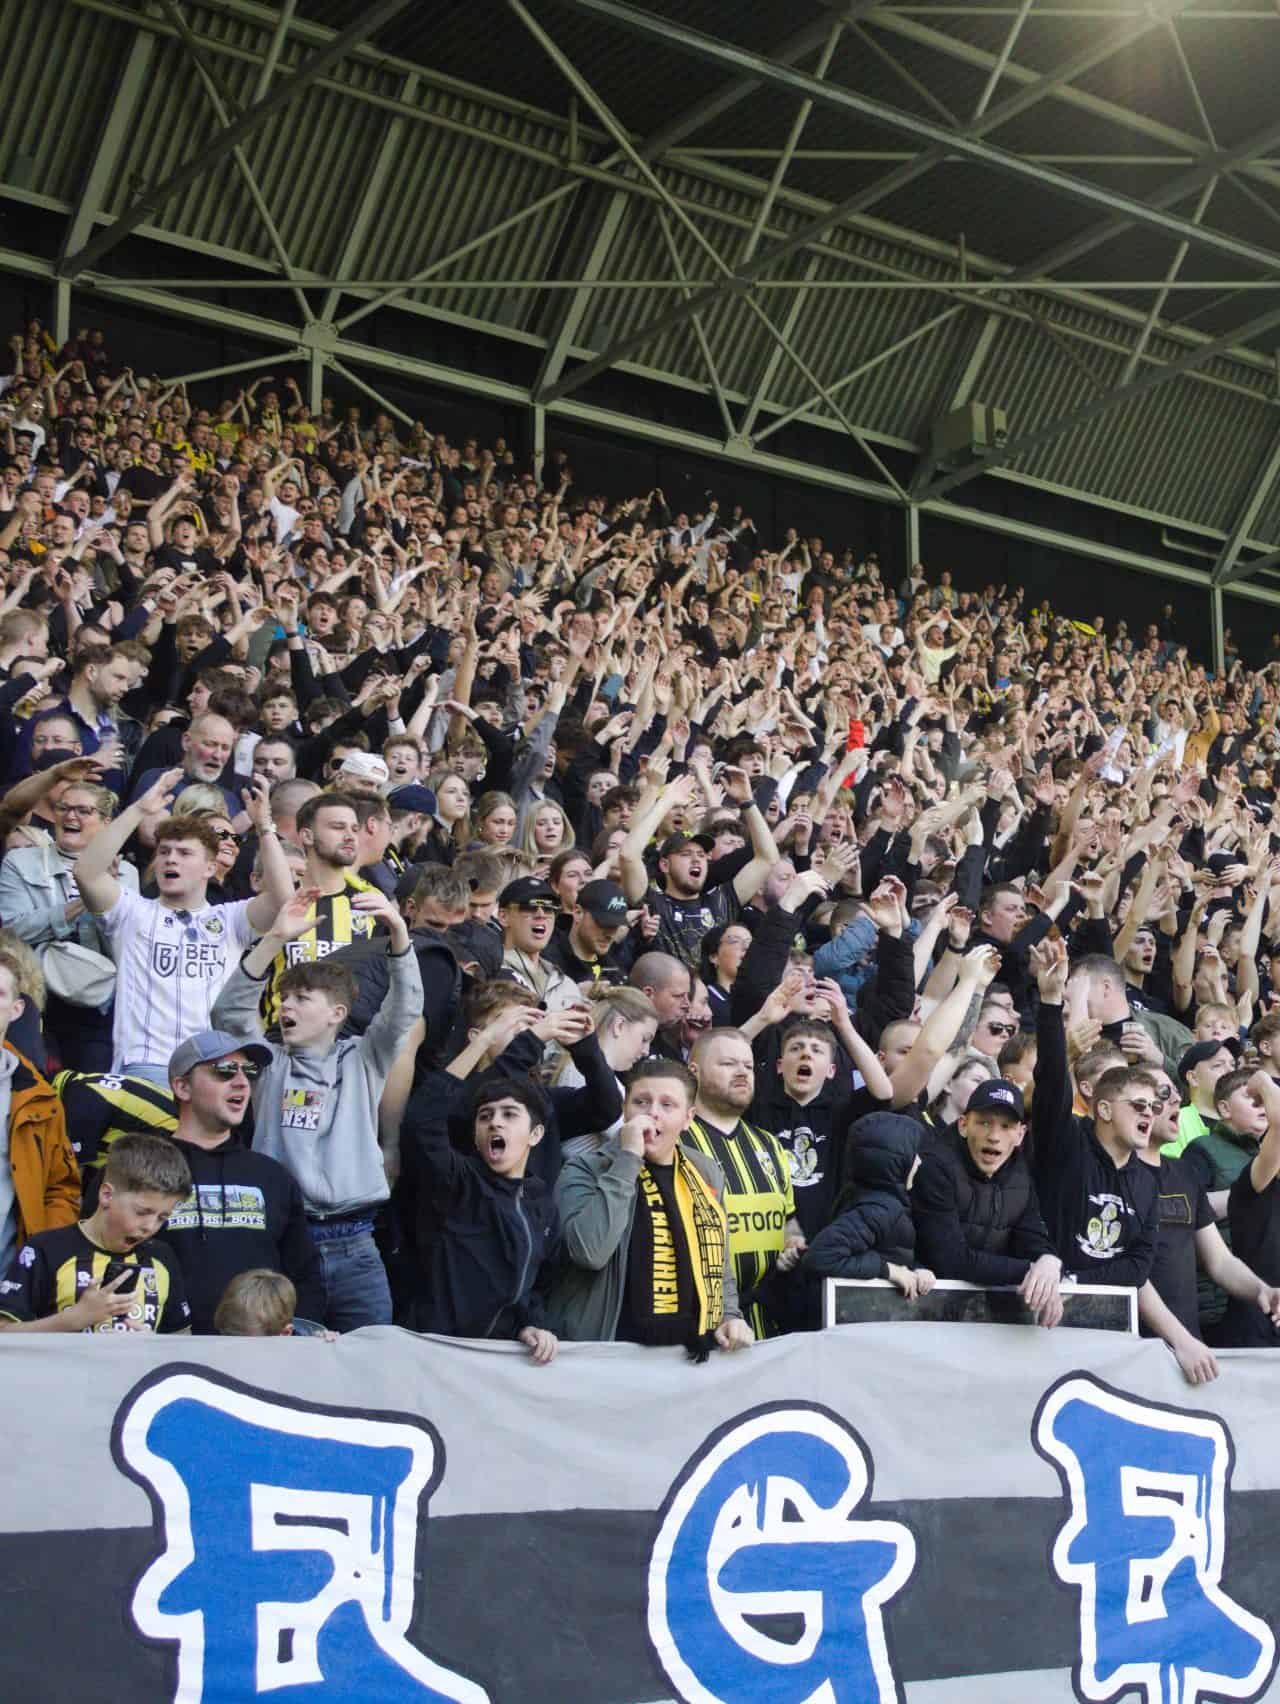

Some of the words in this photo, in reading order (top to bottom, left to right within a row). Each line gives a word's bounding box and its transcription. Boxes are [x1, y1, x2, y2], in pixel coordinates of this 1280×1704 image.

[185, 943, 219, 960] BET
[185, 957, 226, 978] CITY
[231, 1215, 265, 1226] BOYS
[651, 1211, 679, 1314] ARNHEM
